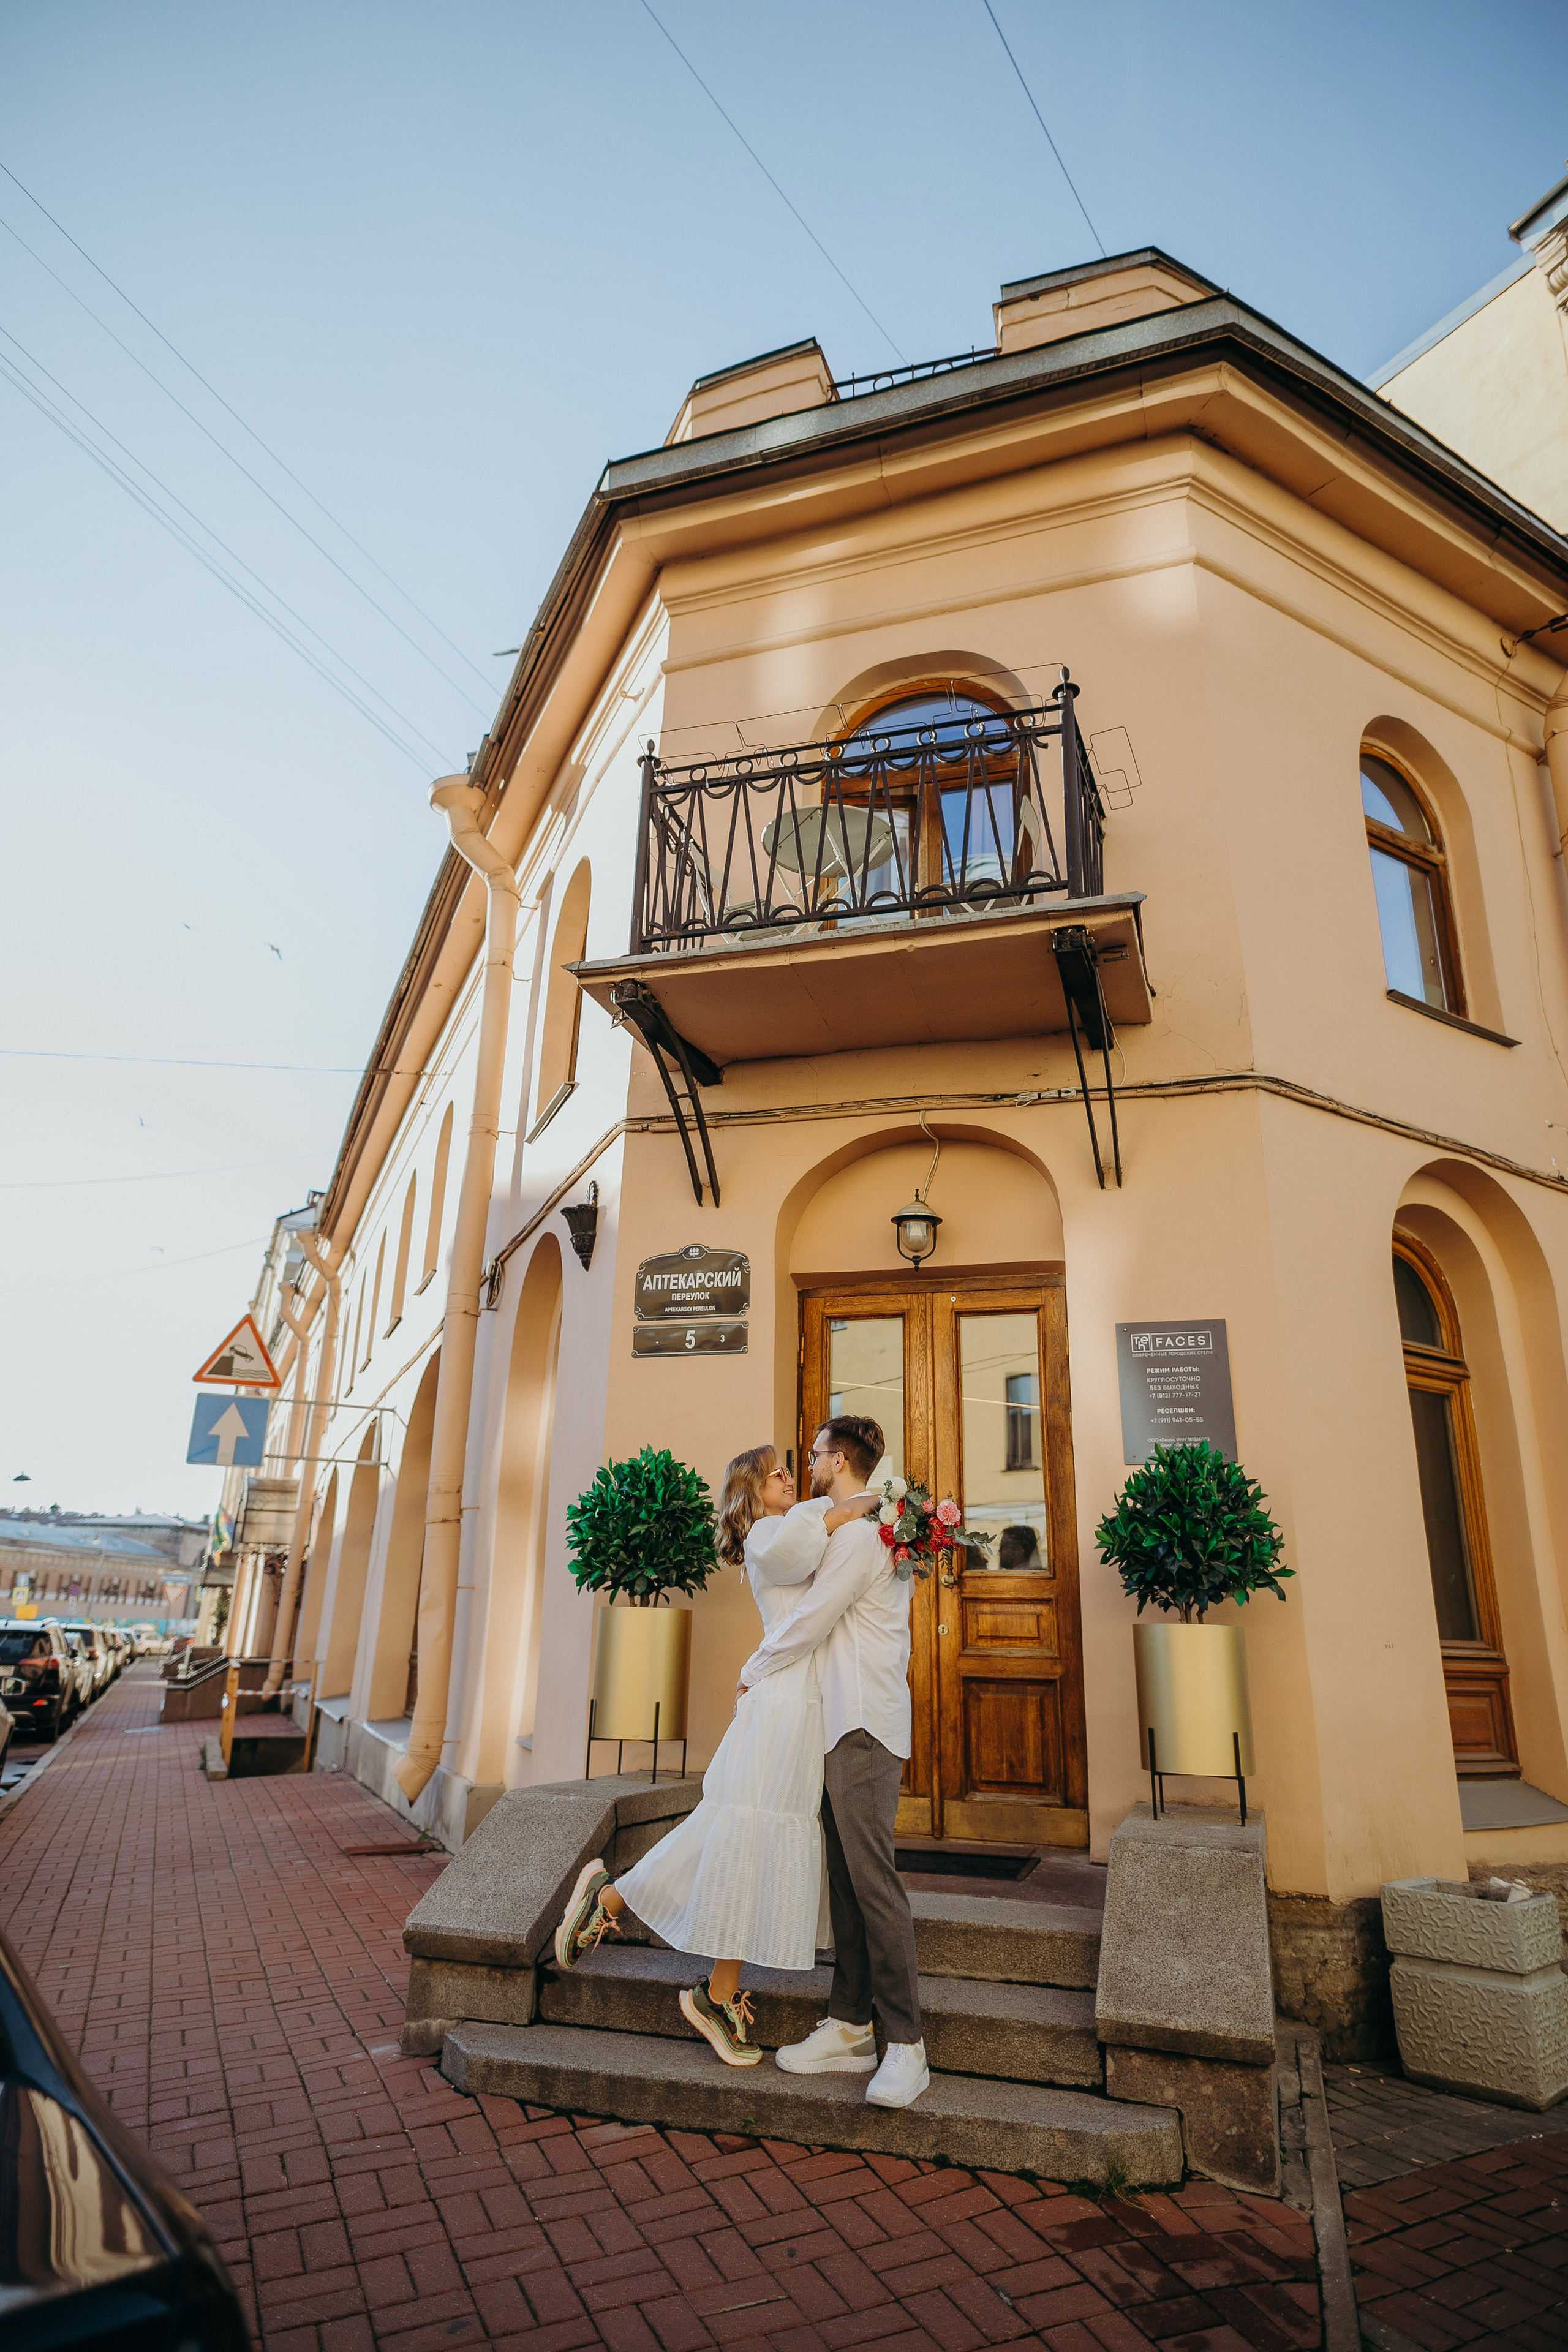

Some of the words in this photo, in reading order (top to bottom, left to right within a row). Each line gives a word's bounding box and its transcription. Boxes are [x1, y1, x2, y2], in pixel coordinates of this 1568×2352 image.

[642, 1267, 742, 1291] АПТЕКАРСКИЙ
[671, 1292, 710, 1301] ПЕРЕУЛОК
[685, 1330, 696, 1349] 5
[720, 1334, 725, 1343] 3
[1156, 1335, 1206, 1348] FACES
